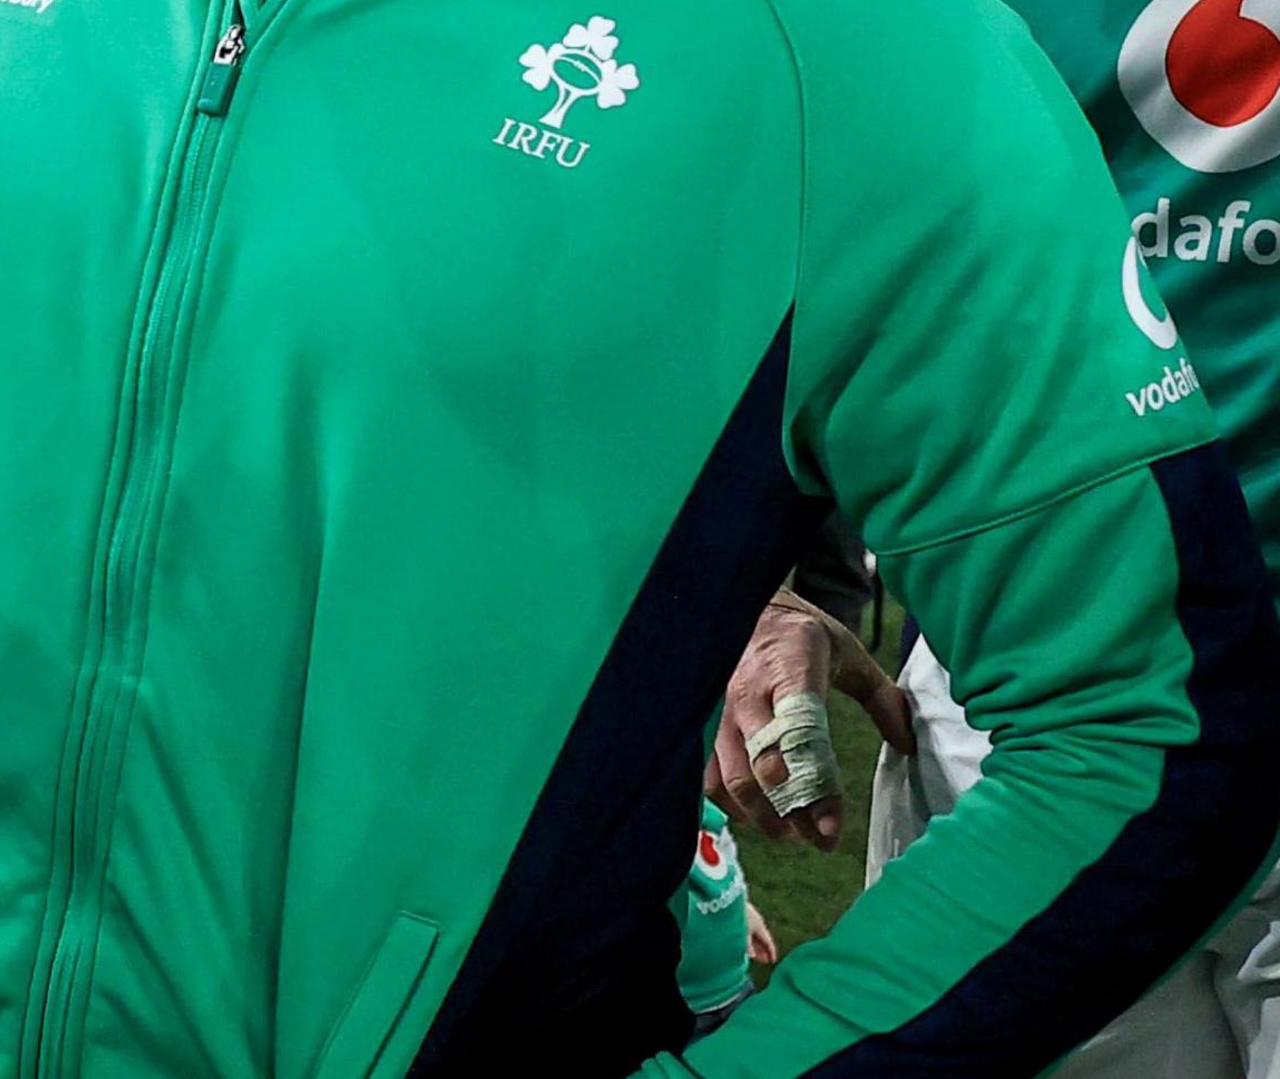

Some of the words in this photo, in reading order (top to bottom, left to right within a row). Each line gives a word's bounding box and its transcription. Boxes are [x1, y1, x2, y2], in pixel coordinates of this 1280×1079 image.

[492, 118, 591, 168] IRFU
[1131, 197, 1280, 265] dafo
[1125, 357, 1200, 416] vodaf
